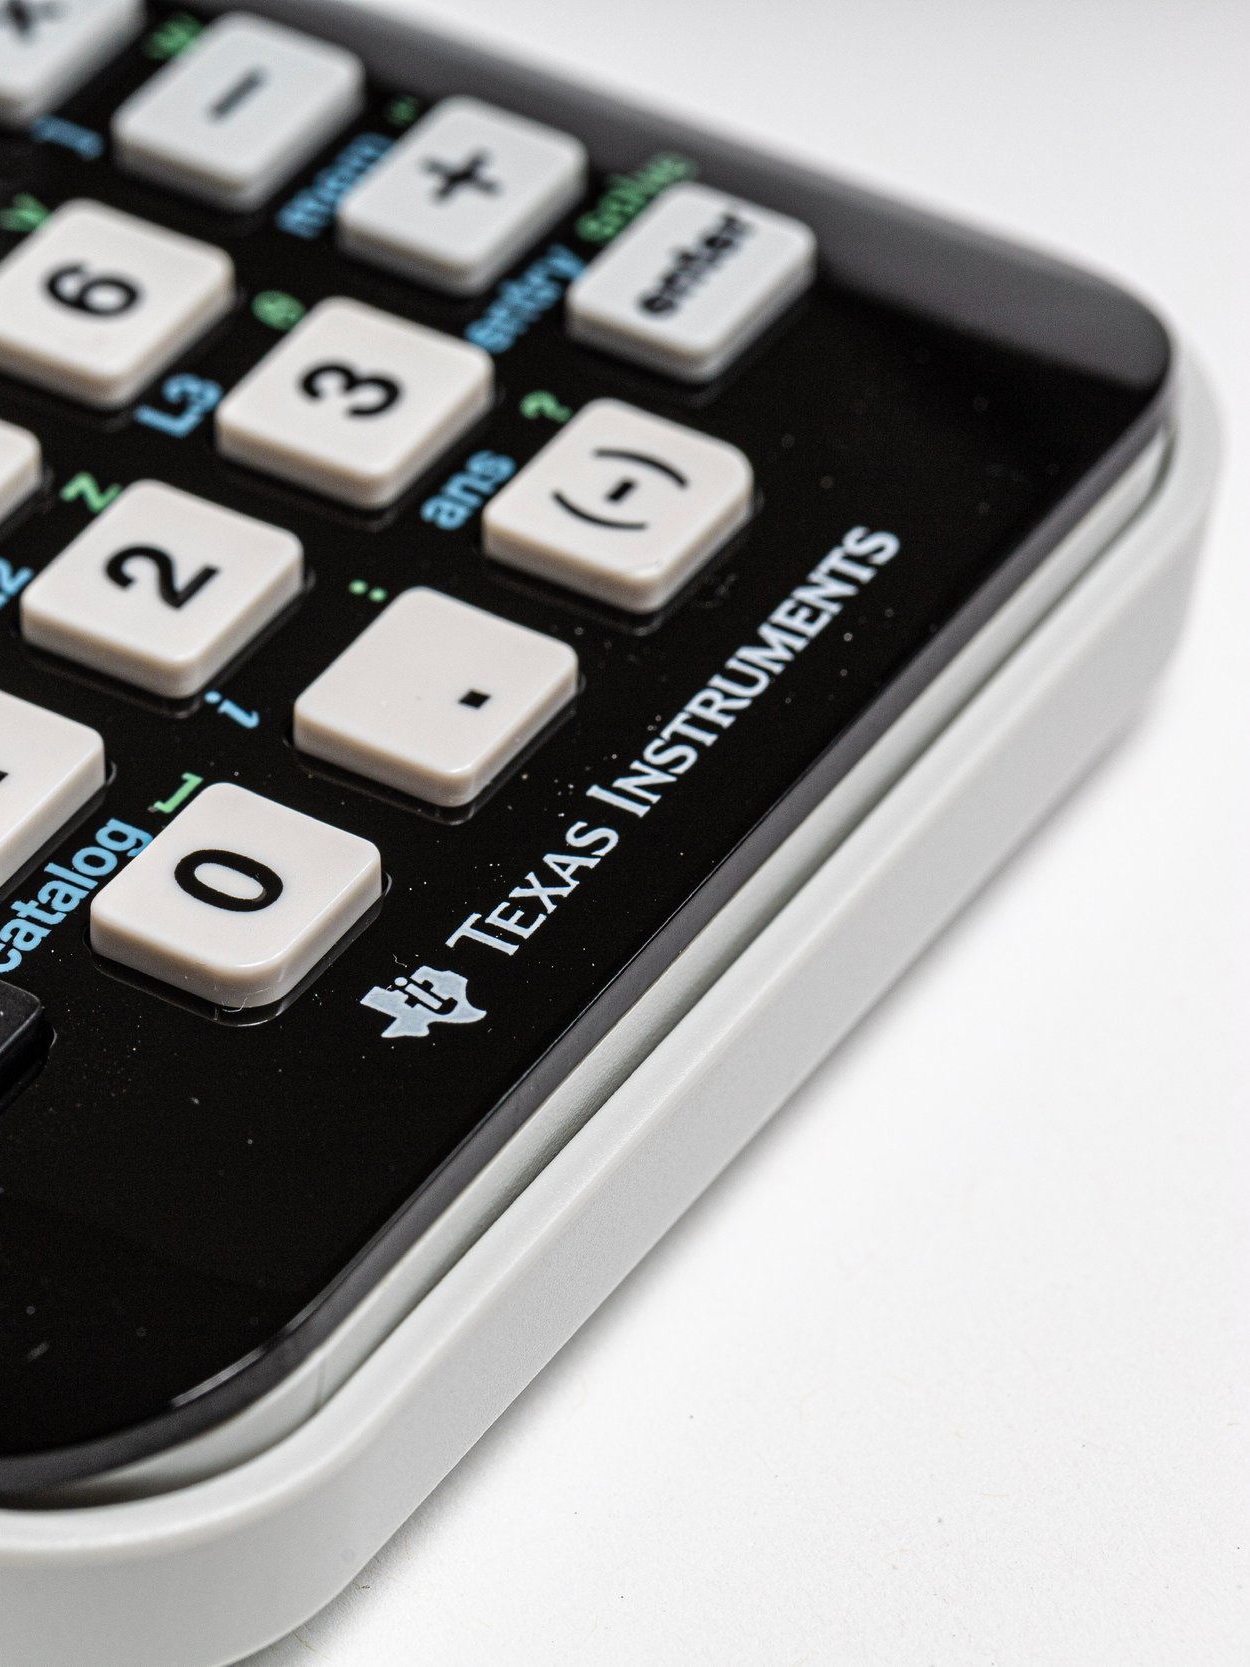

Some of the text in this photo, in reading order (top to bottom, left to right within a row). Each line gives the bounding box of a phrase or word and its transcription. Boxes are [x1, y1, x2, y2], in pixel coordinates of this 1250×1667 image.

[45, 265, 140, 317] 6
[637, 212, 752, 318] enter
[466, 247, 586, 352] entry
[136, 375, 222, 436] L3
[300, 363, 401, 417] 3
[521, 392, 571, 422] ?
[63, 473, 120, 512] Z
[422, 451, 515, 529] ans
[105, 546, 218, 609] 2
[206, 691, 260, 727] i
[445, 524, 901, 955] TEXAS INSTRUMENTS
[174, 849, 283, 912] 0
